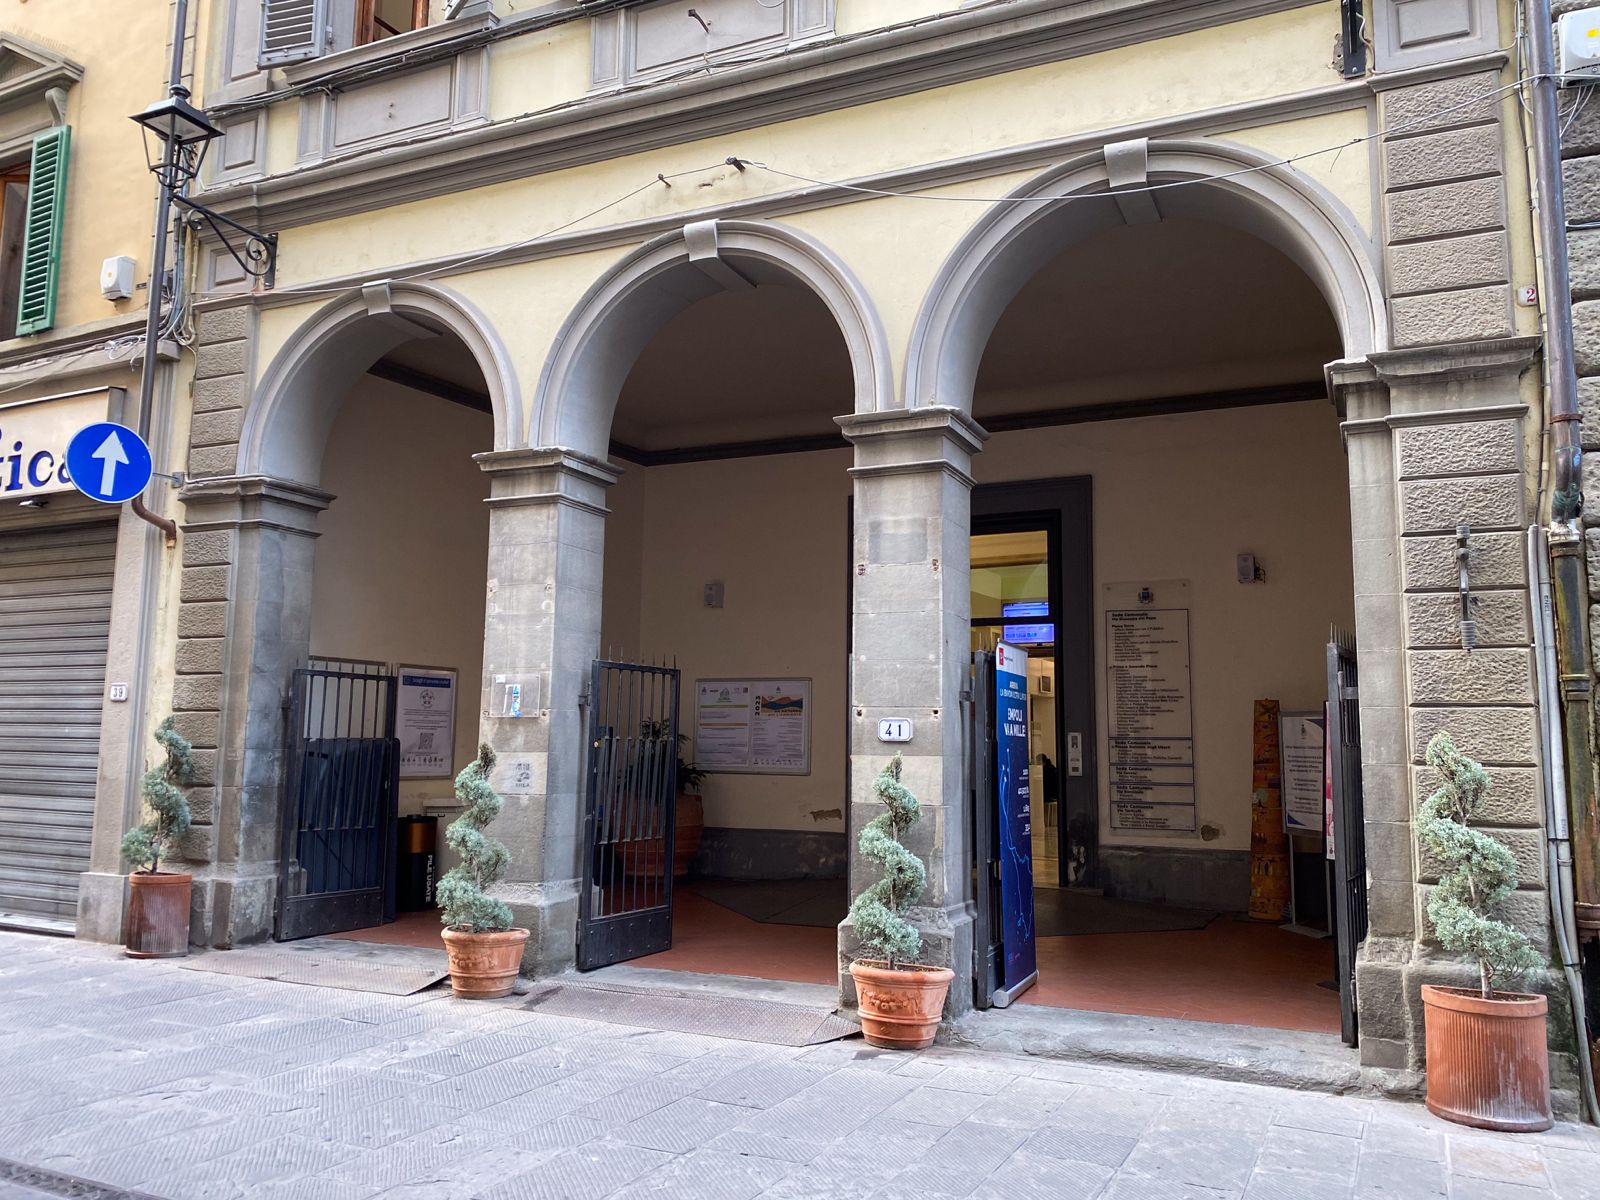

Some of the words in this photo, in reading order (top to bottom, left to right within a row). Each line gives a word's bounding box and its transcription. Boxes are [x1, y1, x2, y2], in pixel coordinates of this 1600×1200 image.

[1526, 288, 1536, 303] 2
[0, 428, 71, 492] ic
[113, 687, 123, 698] 39
[1008, 708, 1022, 721] EMPOLI
[885, 723, 902, 737] 41
[425, 874, 433, 903] USATE
